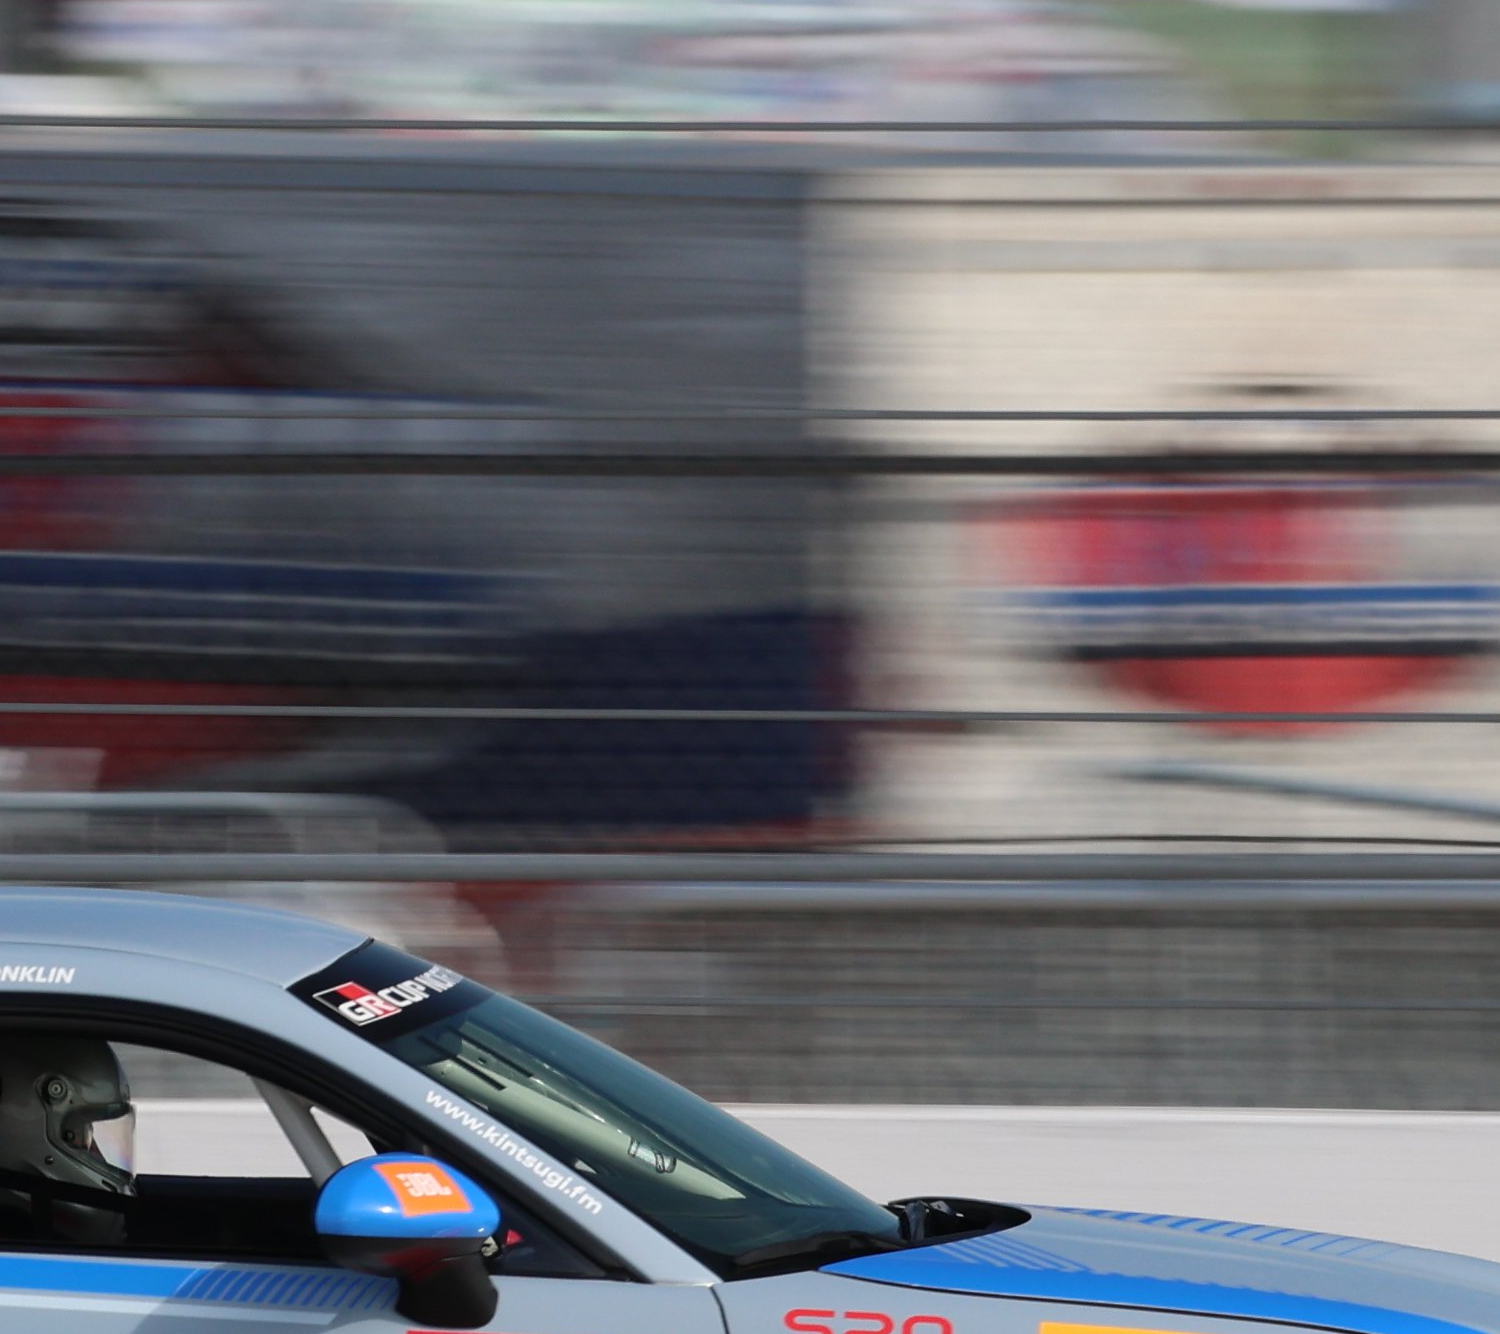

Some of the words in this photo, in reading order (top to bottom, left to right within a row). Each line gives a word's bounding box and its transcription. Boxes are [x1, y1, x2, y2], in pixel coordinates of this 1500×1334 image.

[337, 994, 396, 1021] GR
[377, 979, 431, 1007] CUP
[425, 1090, 603, 1215] www.kintsugi.fm
